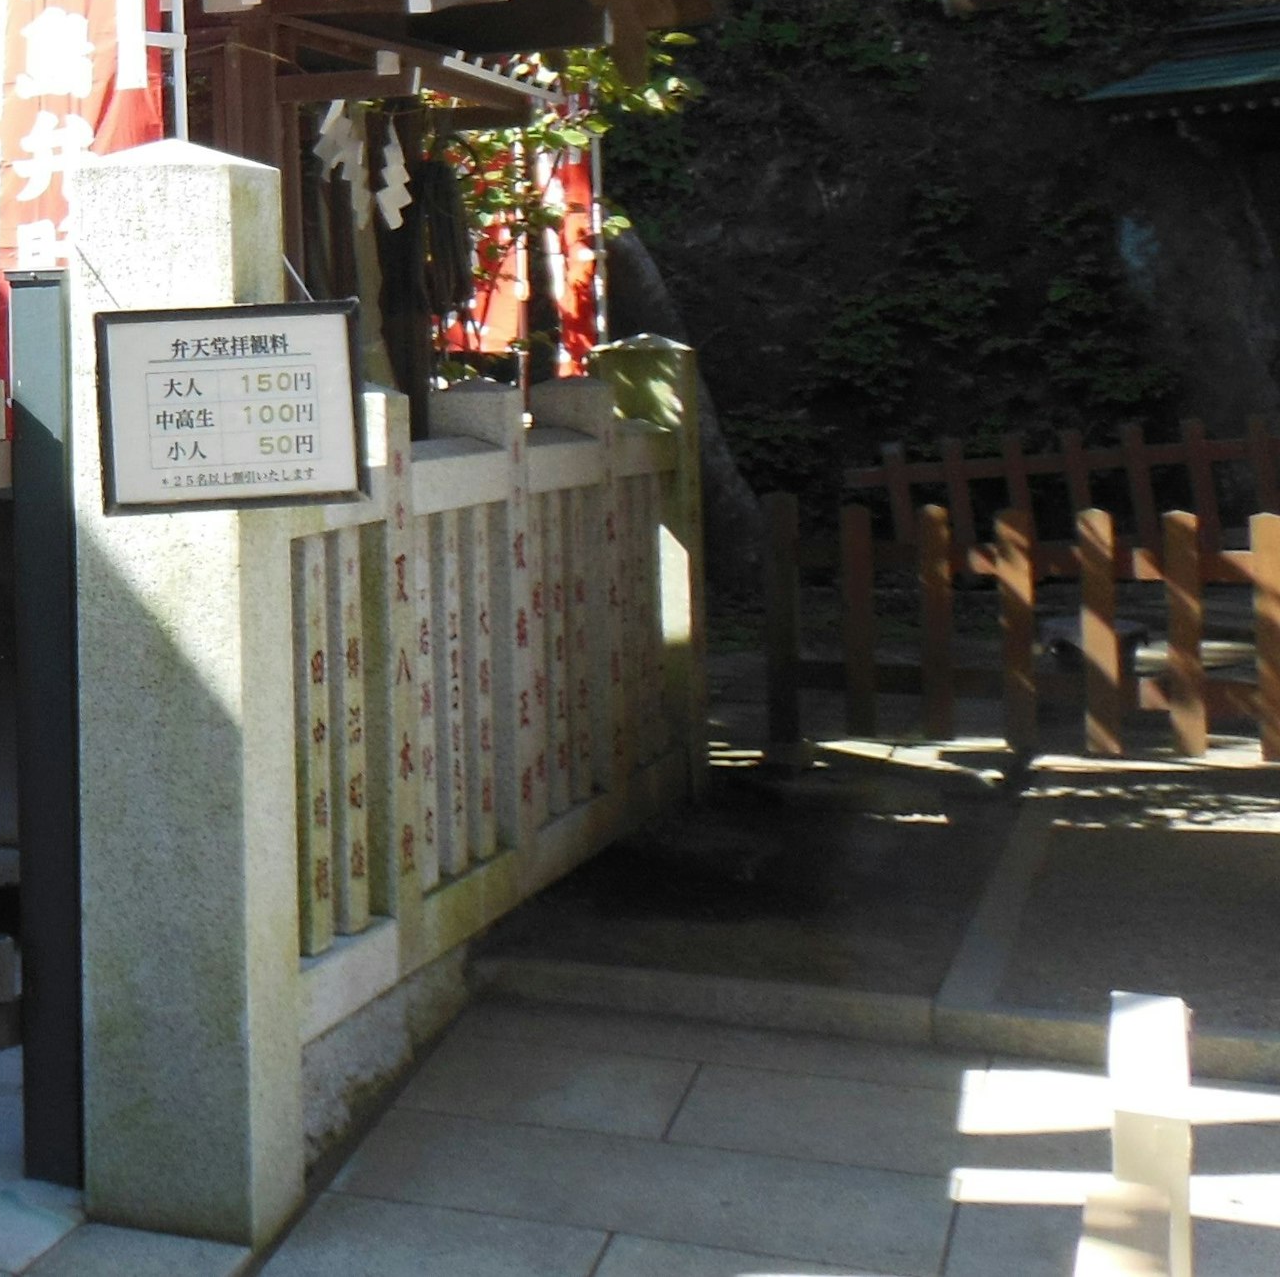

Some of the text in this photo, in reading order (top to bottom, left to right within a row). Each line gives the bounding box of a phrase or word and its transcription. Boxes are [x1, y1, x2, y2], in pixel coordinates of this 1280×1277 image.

[171, 333, 289, 359] 弁天堂拝観料
[163, 377, 203, 399] 大人
[242, 371, 312, 393] 150円
[156, 409, 215, 431] 中高生
[243, 403, 314, 425] 100円
[167, 440, 207, 461] 小人
[259, 434, 314, 456] 50円
